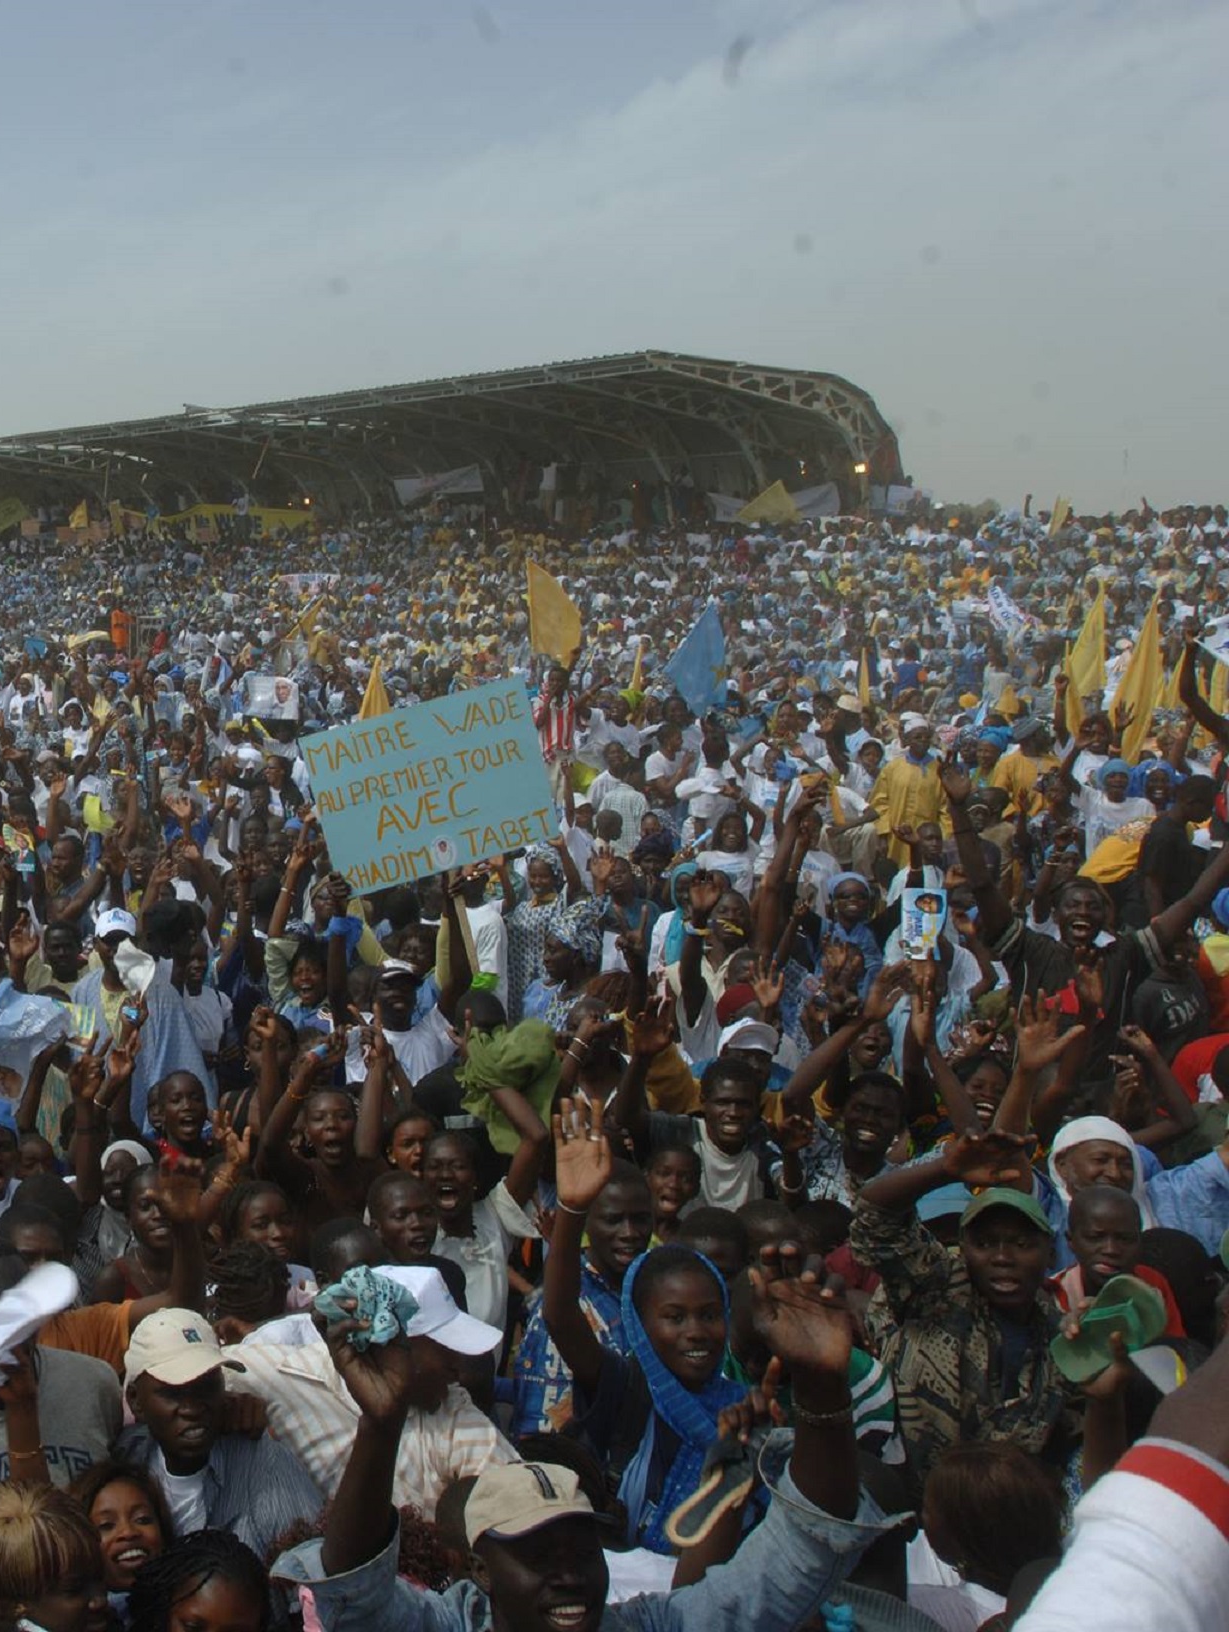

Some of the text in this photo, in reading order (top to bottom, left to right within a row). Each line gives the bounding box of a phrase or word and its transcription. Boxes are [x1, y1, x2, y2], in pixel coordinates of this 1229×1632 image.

[432, 691, 526, 736] WADE
[316, 787, 345, 818] AU
[454, 739, 524, 773] TOUR
[377, 781, 479, 842] AVEC
[460, 807, 551, 858] TABET
